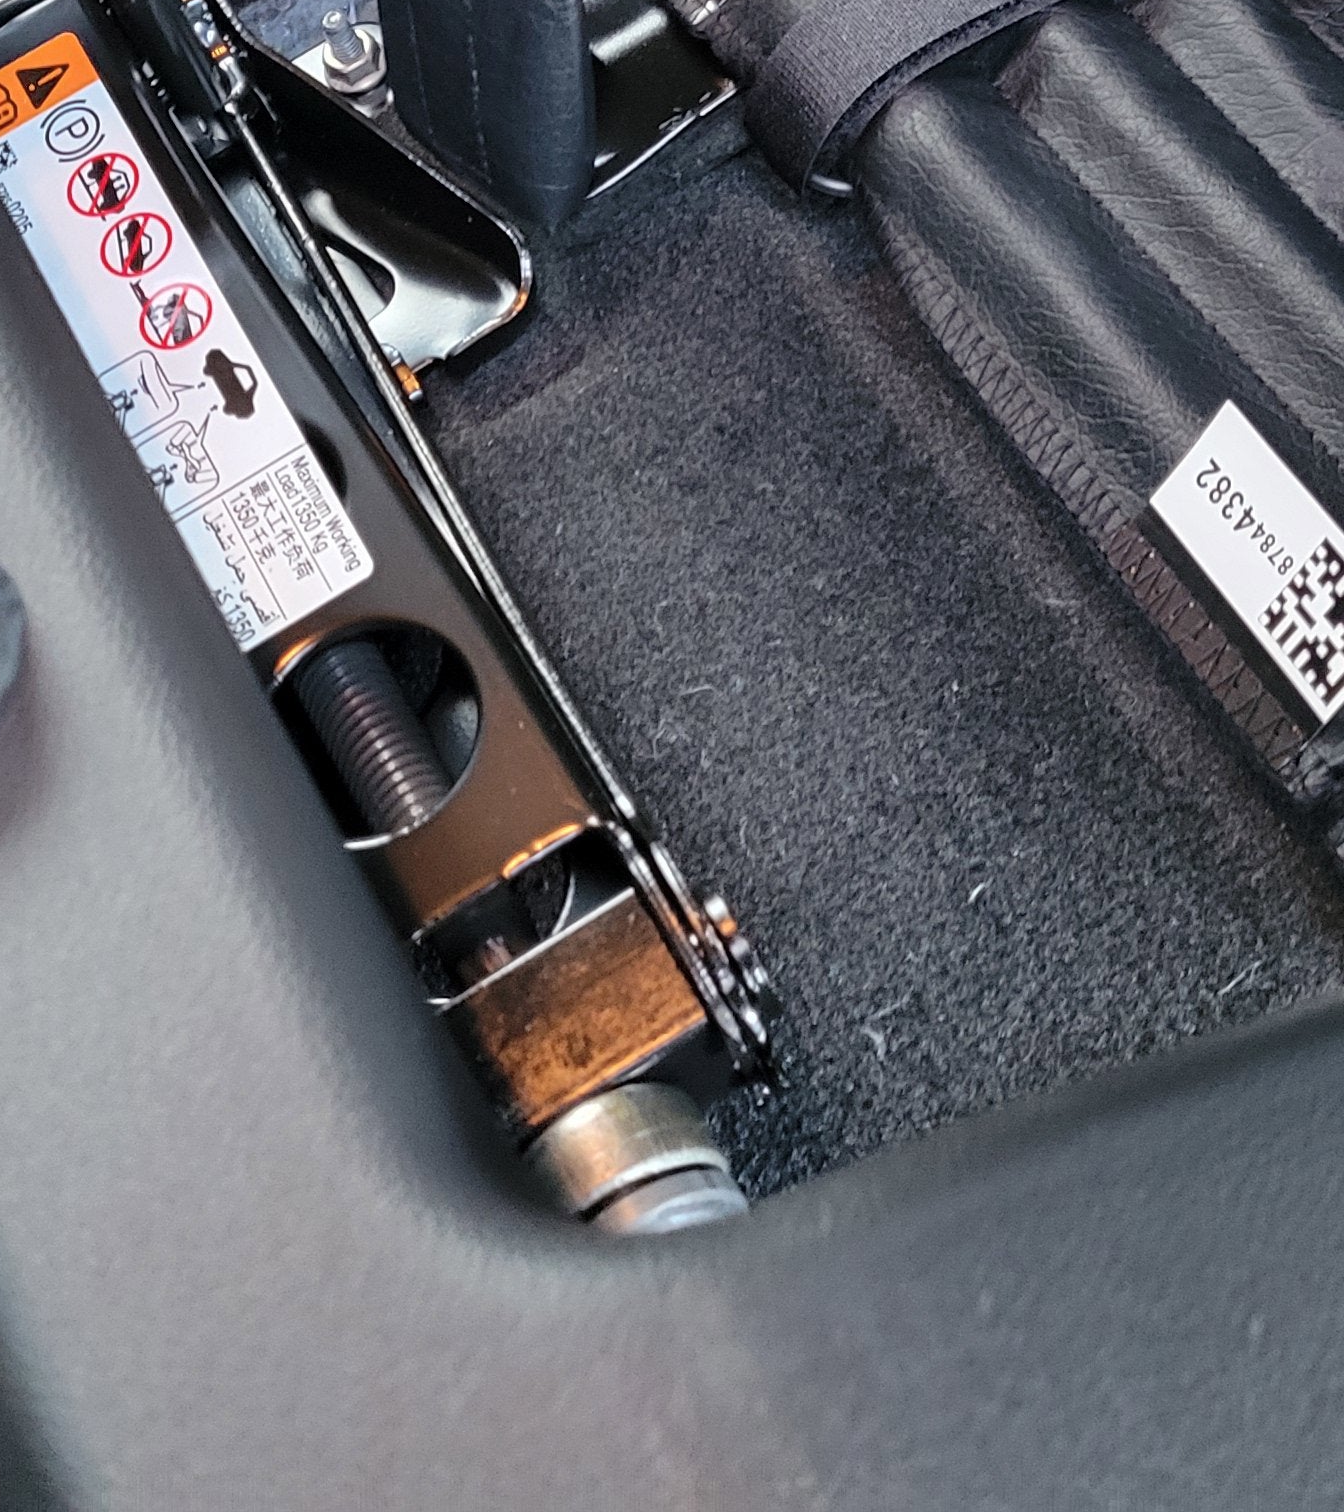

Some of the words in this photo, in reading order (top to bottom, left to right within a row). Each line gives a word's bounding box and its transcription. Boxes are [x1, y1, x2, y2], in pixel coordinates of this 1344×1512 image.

[249, 479, 315, 581] 最大工作负荷
[274, 464, 303, 500] Load
[291, 495, 321, 533] 1350
[310, 530, 328, 555] Kg
[290, 454, 332, 520] Maximum
[325, 514, 361, 573] Working
[1196, 457, 1294, 576] 87844382
[225, 603, 256, 643] 1350
